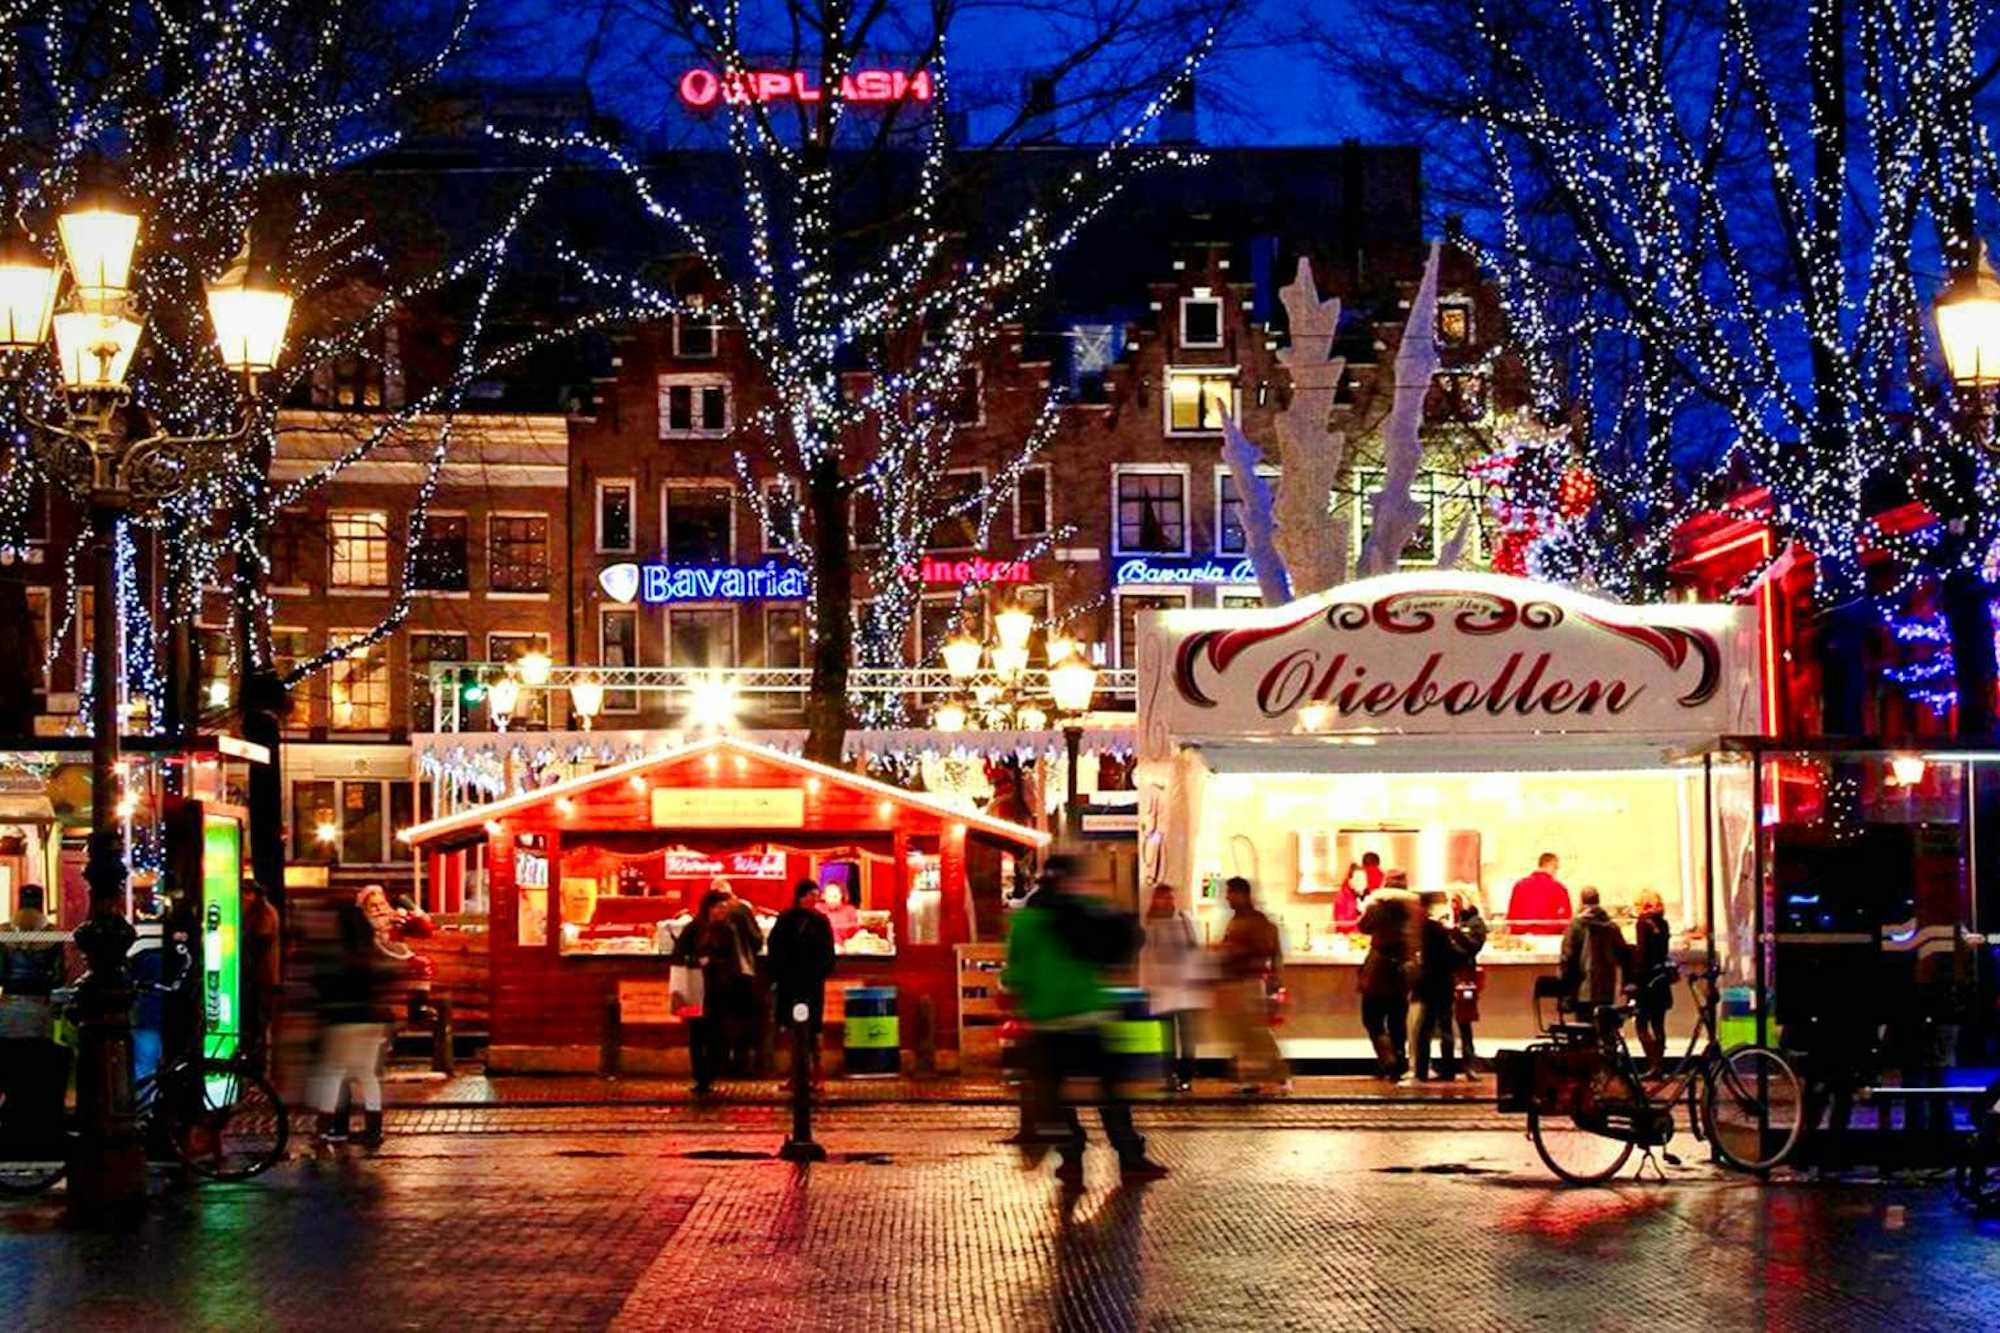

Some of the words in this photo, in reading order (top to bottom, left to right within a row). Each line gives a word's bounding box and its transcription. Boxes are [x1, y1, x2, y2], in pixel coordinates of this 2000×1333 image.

[642, 560, 807, 602] Bavaria
[1117, 557, 1225, 583] Bavaria
[1256, 648, 1648, 719] Oliebollen
